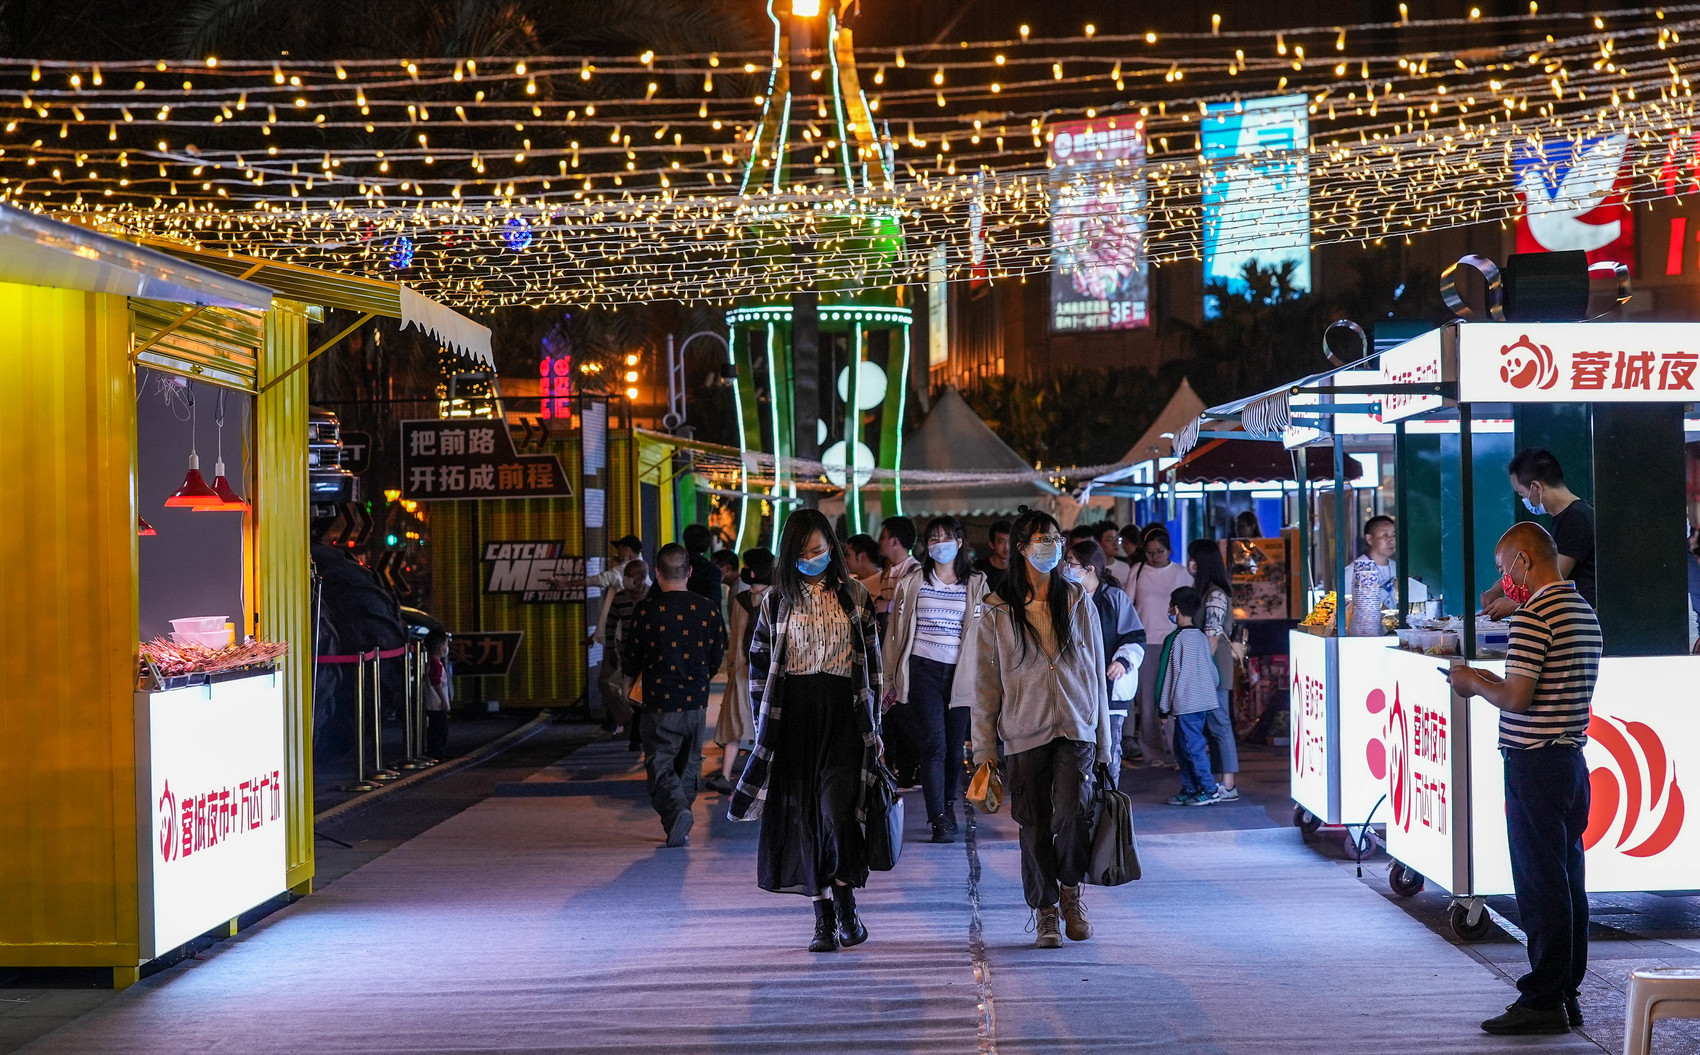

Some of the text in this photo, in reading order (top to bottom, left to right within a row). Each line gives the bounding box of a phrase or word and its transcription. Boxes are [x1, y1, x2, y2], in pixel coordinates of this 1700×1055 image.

[1110, 300, 1132, 323] 3F
[1570, 351, 1700, 391] 蓉城夜
[410, 428, 495, 456] 把前路
[409, 463, 554, 492] 开拓成前程
[485, 543, 549, 559] CATCH
[488, 560, 557, 591] ME
[523, 591, 535, 601] IF
[537, 591, 562, 601] YOU
[1414, 771, 1447, 836] 万达广场
